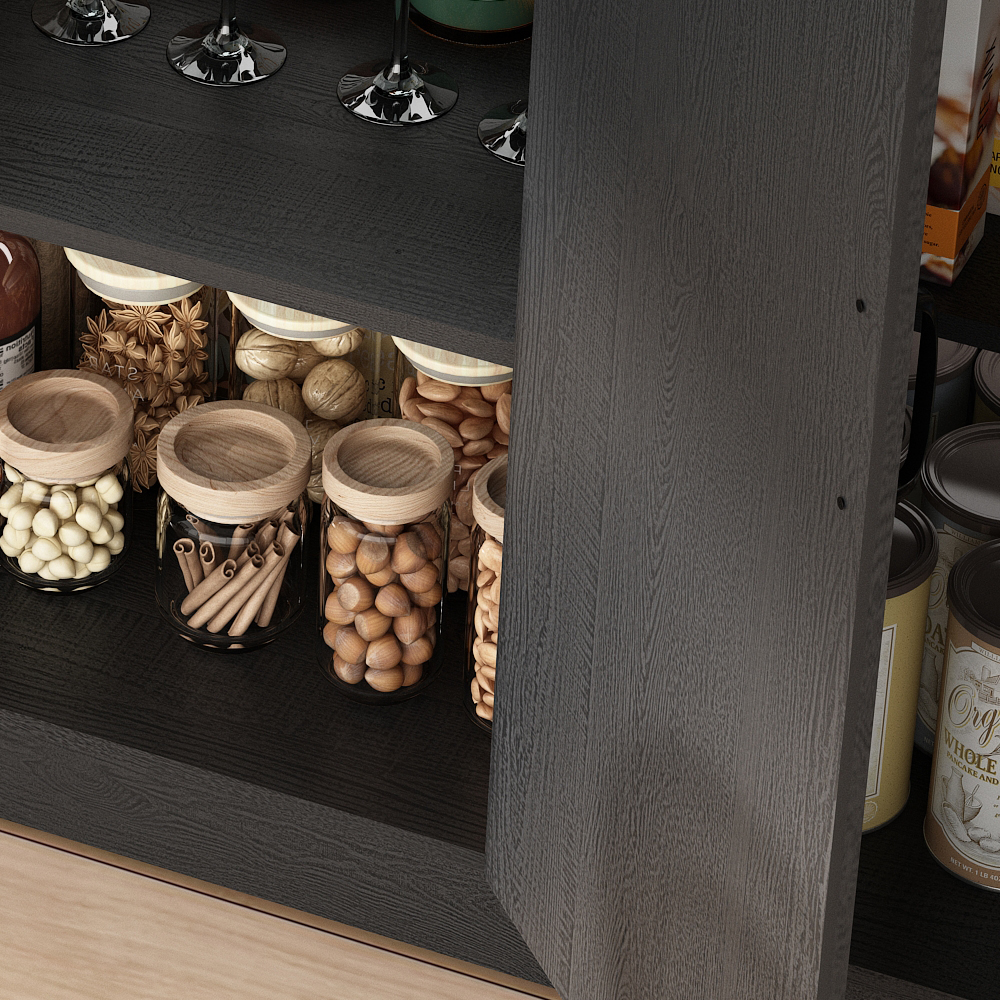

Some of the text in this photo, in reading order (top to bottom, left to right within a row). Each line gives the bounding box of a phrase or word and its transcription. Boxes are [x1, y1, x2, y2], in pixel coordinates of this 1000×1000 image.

[944, 726, 998, 776] WHOLE
[946, 750, 999, 786] PANCAKE AND
[950, 856, 963, 867] NET
[962, 863, 974, 874] WT.
[979, 870, 989, 879] LB
